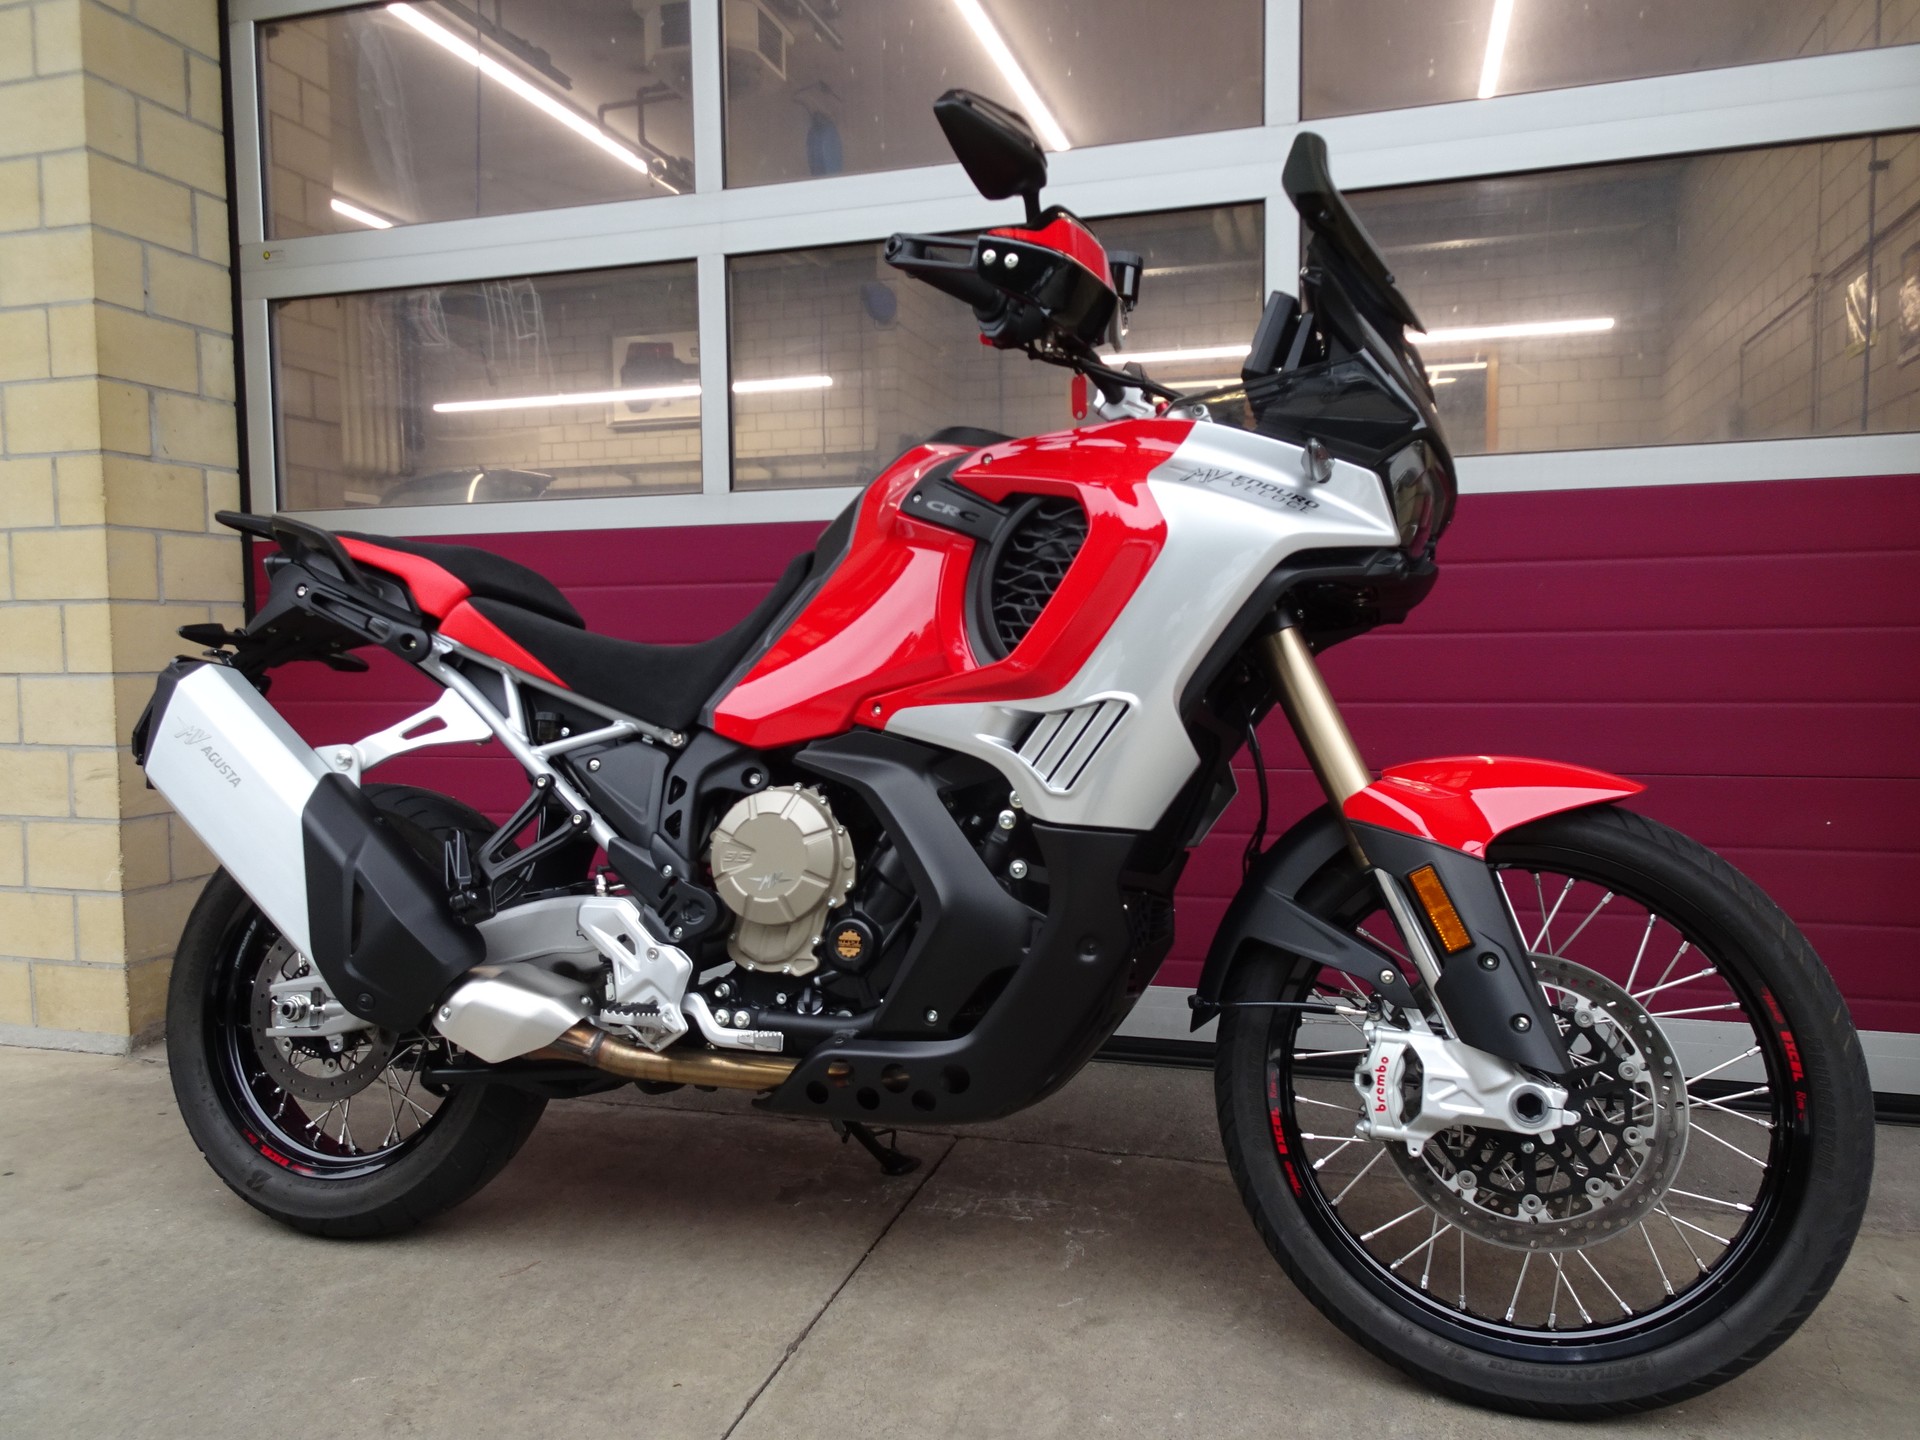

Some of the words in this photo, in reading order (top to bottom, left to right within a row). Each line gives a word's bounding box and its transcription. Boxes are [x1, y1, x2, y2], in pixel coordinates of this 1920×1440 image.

[1231, 482, 1311, 514] VELOCE
[1234, 474, 1321, 510] ENDURO
[925, 500, 981, 524] CRC
[200, 745, 242, 788] AGUSTA
[1375, 1056, 1389, 1113] brembo
